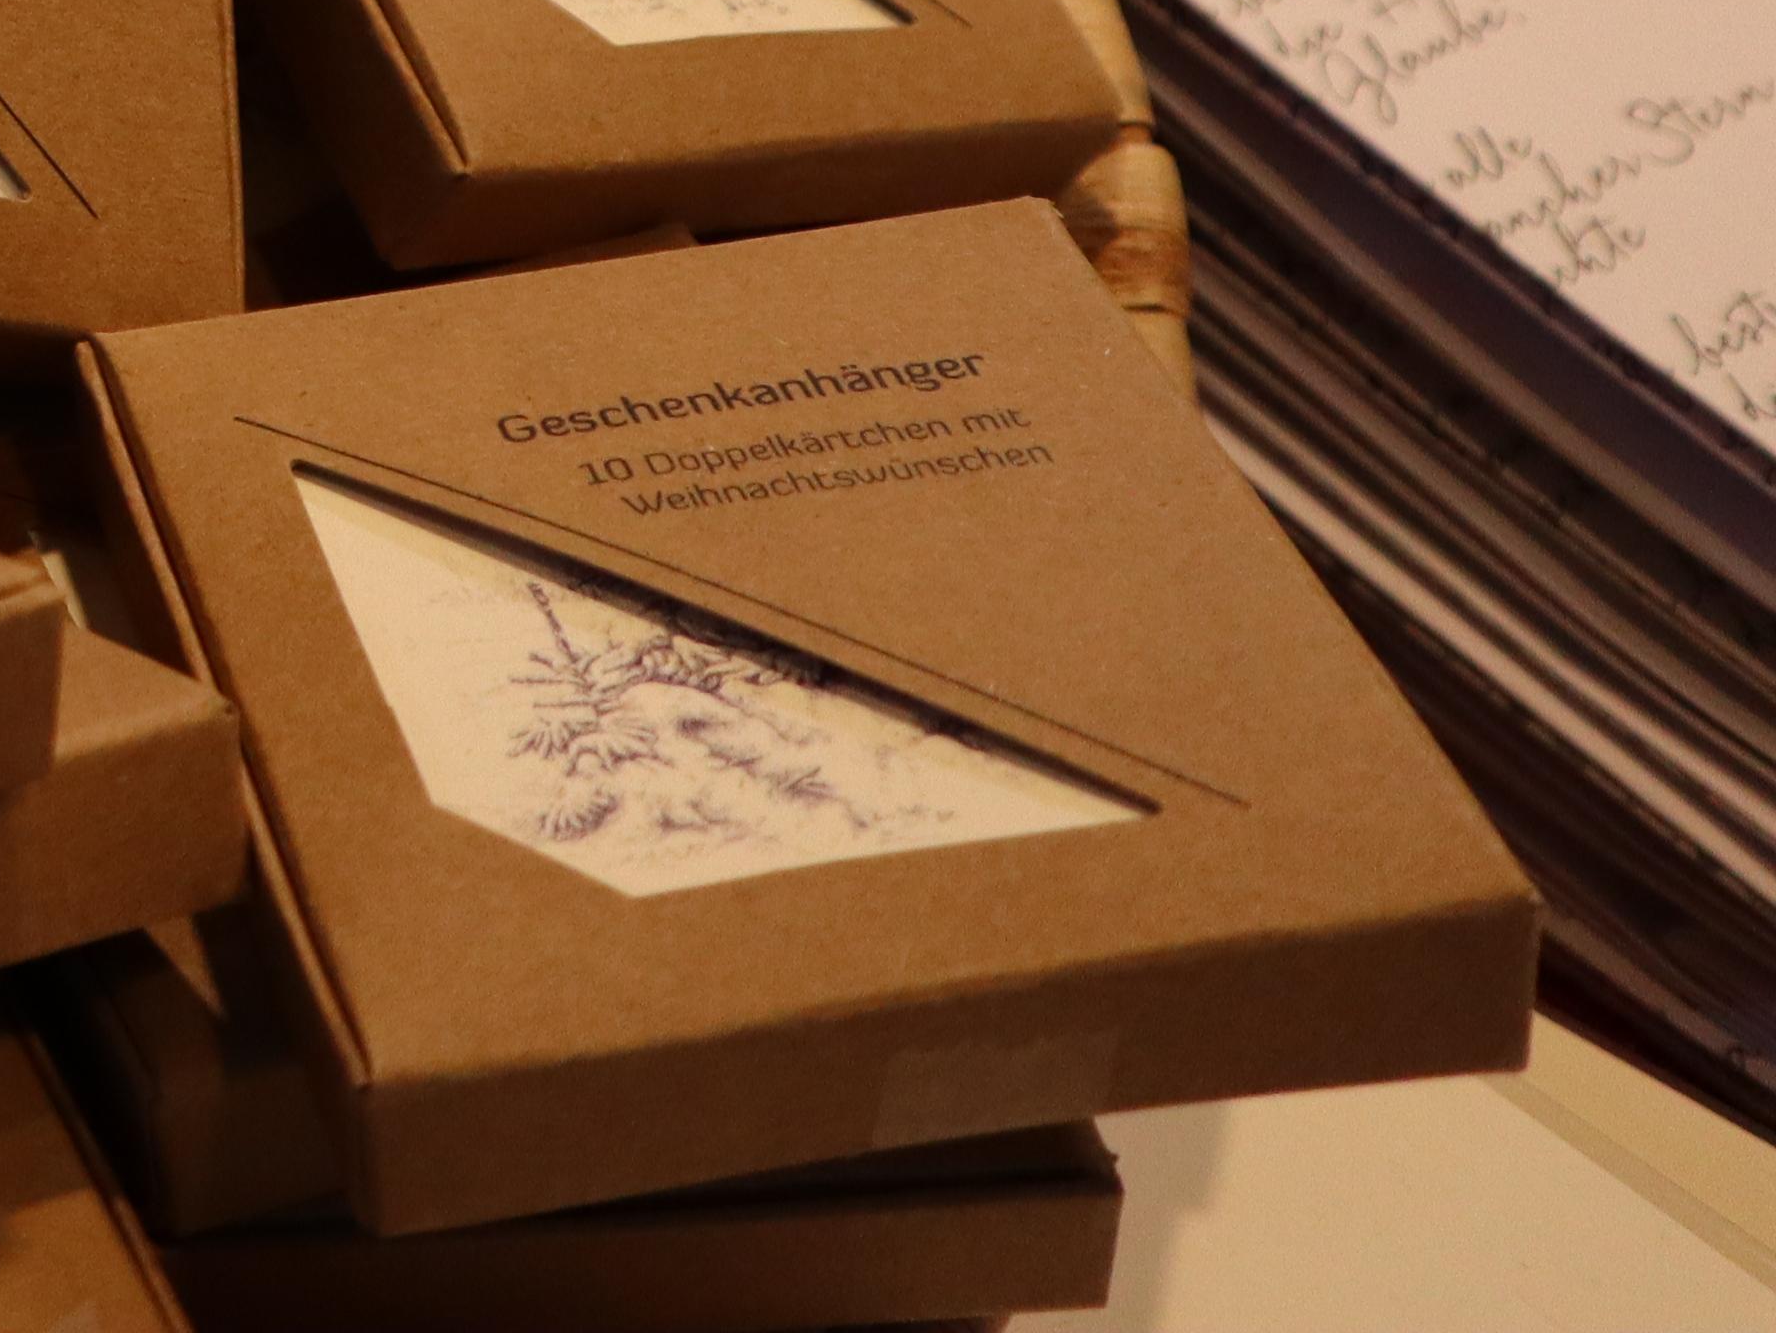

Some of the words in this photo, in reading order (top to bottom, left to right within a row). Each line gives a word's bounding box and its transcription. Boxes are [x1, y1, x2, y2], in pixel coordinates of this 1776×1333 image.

[497, 351, 985, 444] Geschenkanhänger
[578, 456, 634, 487] 10
[643, 417, 952, 478] Doppelkärtchen
[963, 406, 1032, 432] mit
[620, 443, 1054, 518] Weihnachtswünschen
